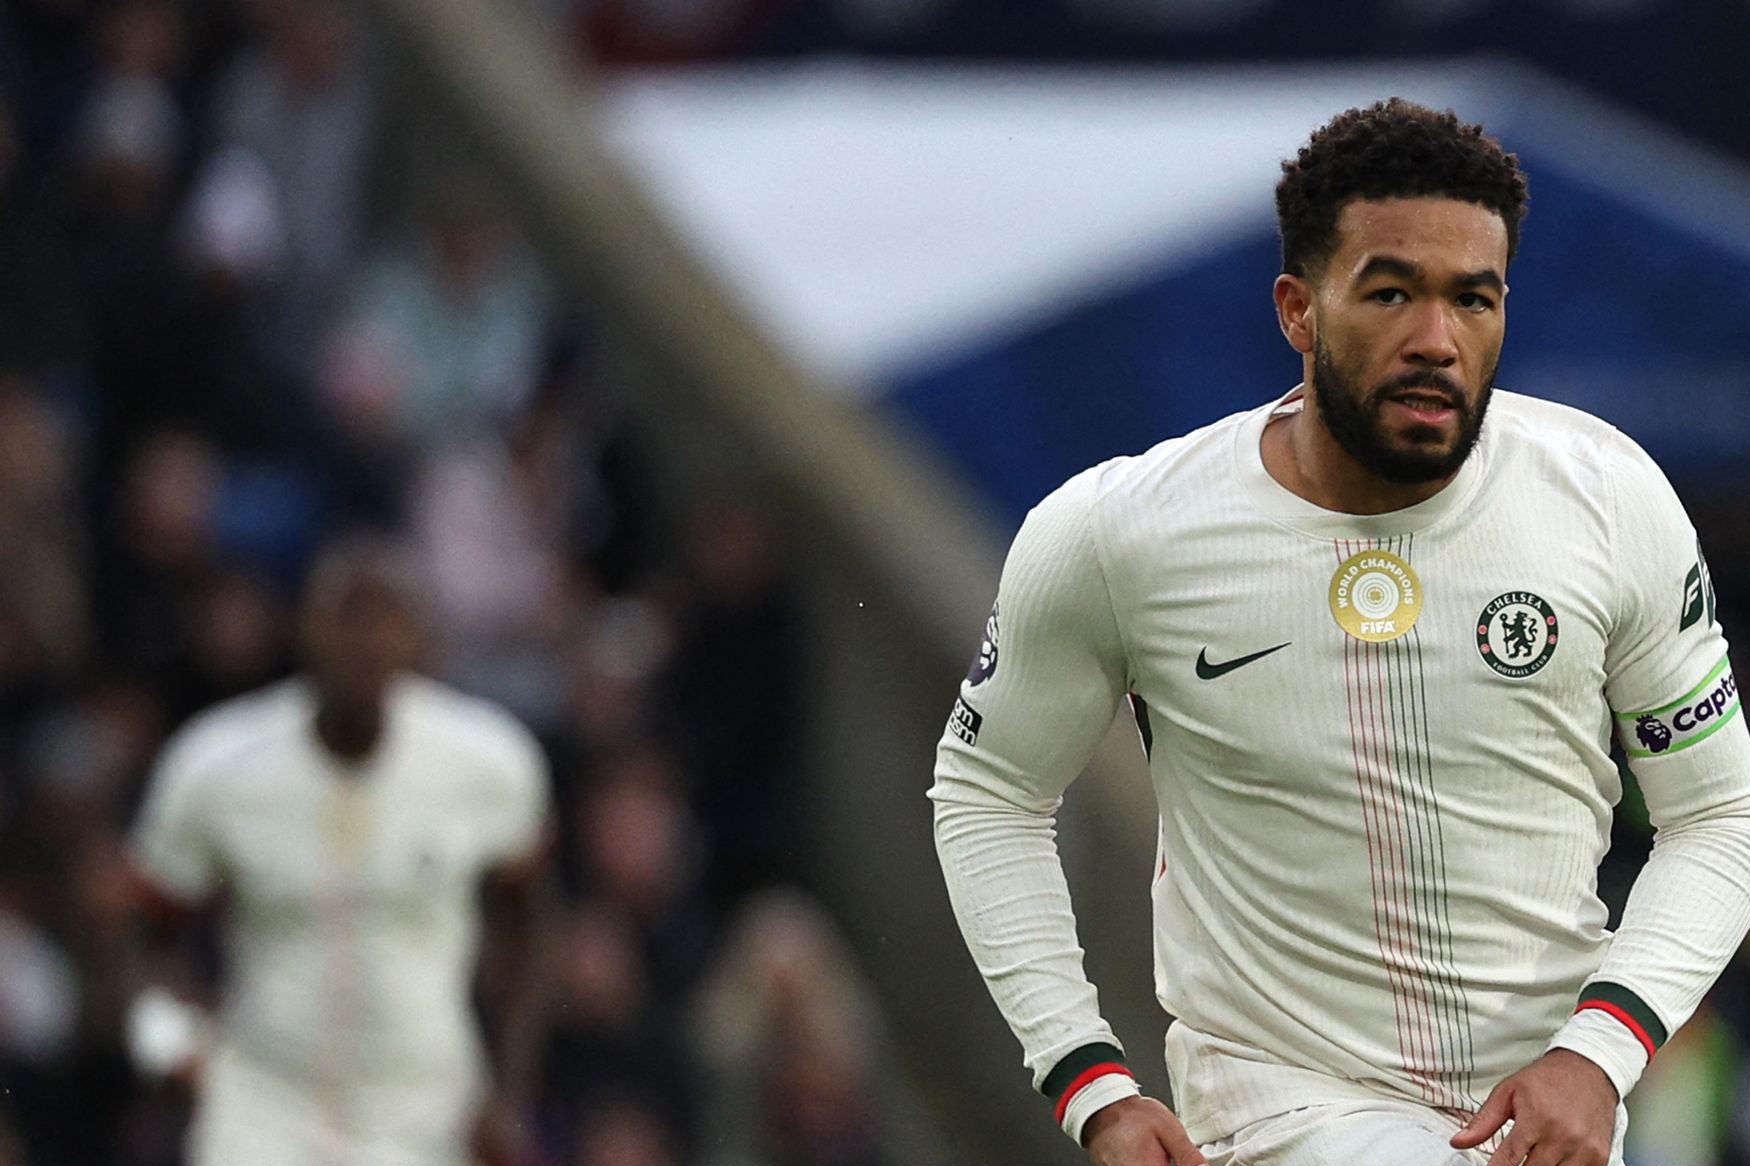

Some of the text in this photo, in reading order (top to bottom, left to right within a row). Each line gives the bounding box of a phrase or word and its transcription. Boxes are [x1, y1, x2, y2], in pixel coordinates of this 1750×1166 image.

[1337, 558, 1414, 609] WORLD CHAMPIONS
[1486, 593, 1542, 615] CHELSEA
[1360, 620, 1396, 634] FIFA
[1493, 654, 1548, 676] FOOTBALL CLUB
